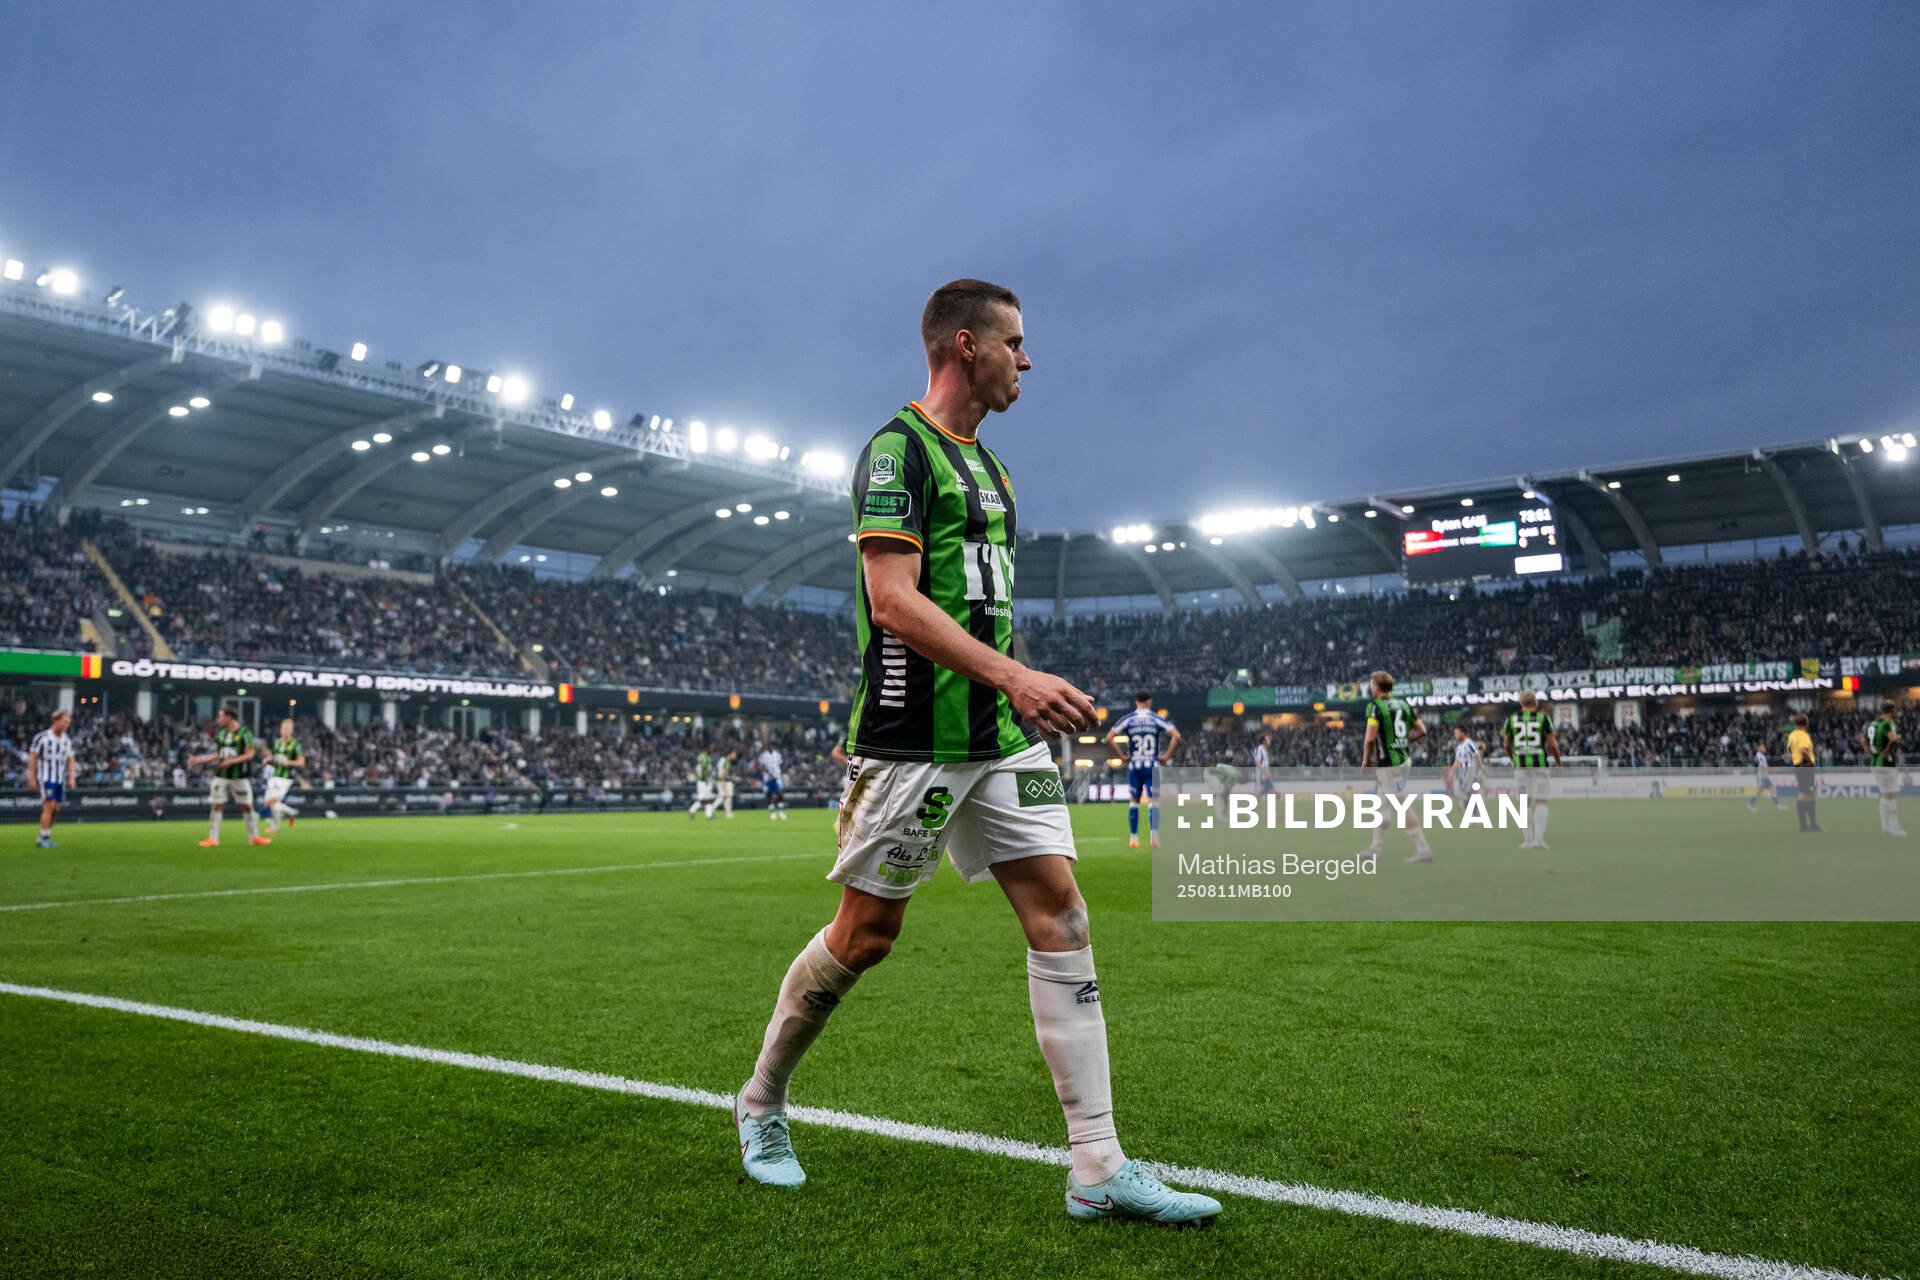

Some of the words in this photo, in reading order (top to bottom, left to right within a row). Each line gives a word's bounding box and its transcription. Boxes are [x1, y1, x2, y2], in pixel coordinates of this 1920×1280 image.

[111, 658, 276, 684] GÖTEBORGS
[1596, 666, 1675, 686] PREPPENS
[1406, 696, 1424, 707] VI
[1425, 694, 1464, 706] SKA
[1465, 690, 1548, 704] SJUNA
[1579, 686, 1624, 699] DET
[1626, 683, 1687, 697] EKAR
[1394, 709, 1406, 737] 6
[1513, 719, 1541, 747] 25
[1131, 734, 1155, 756] 30
[1867, 726, 1876, 745] 9
[903, 827, 929, 837] SAFE
[886, 843, 912, 861] Åke
